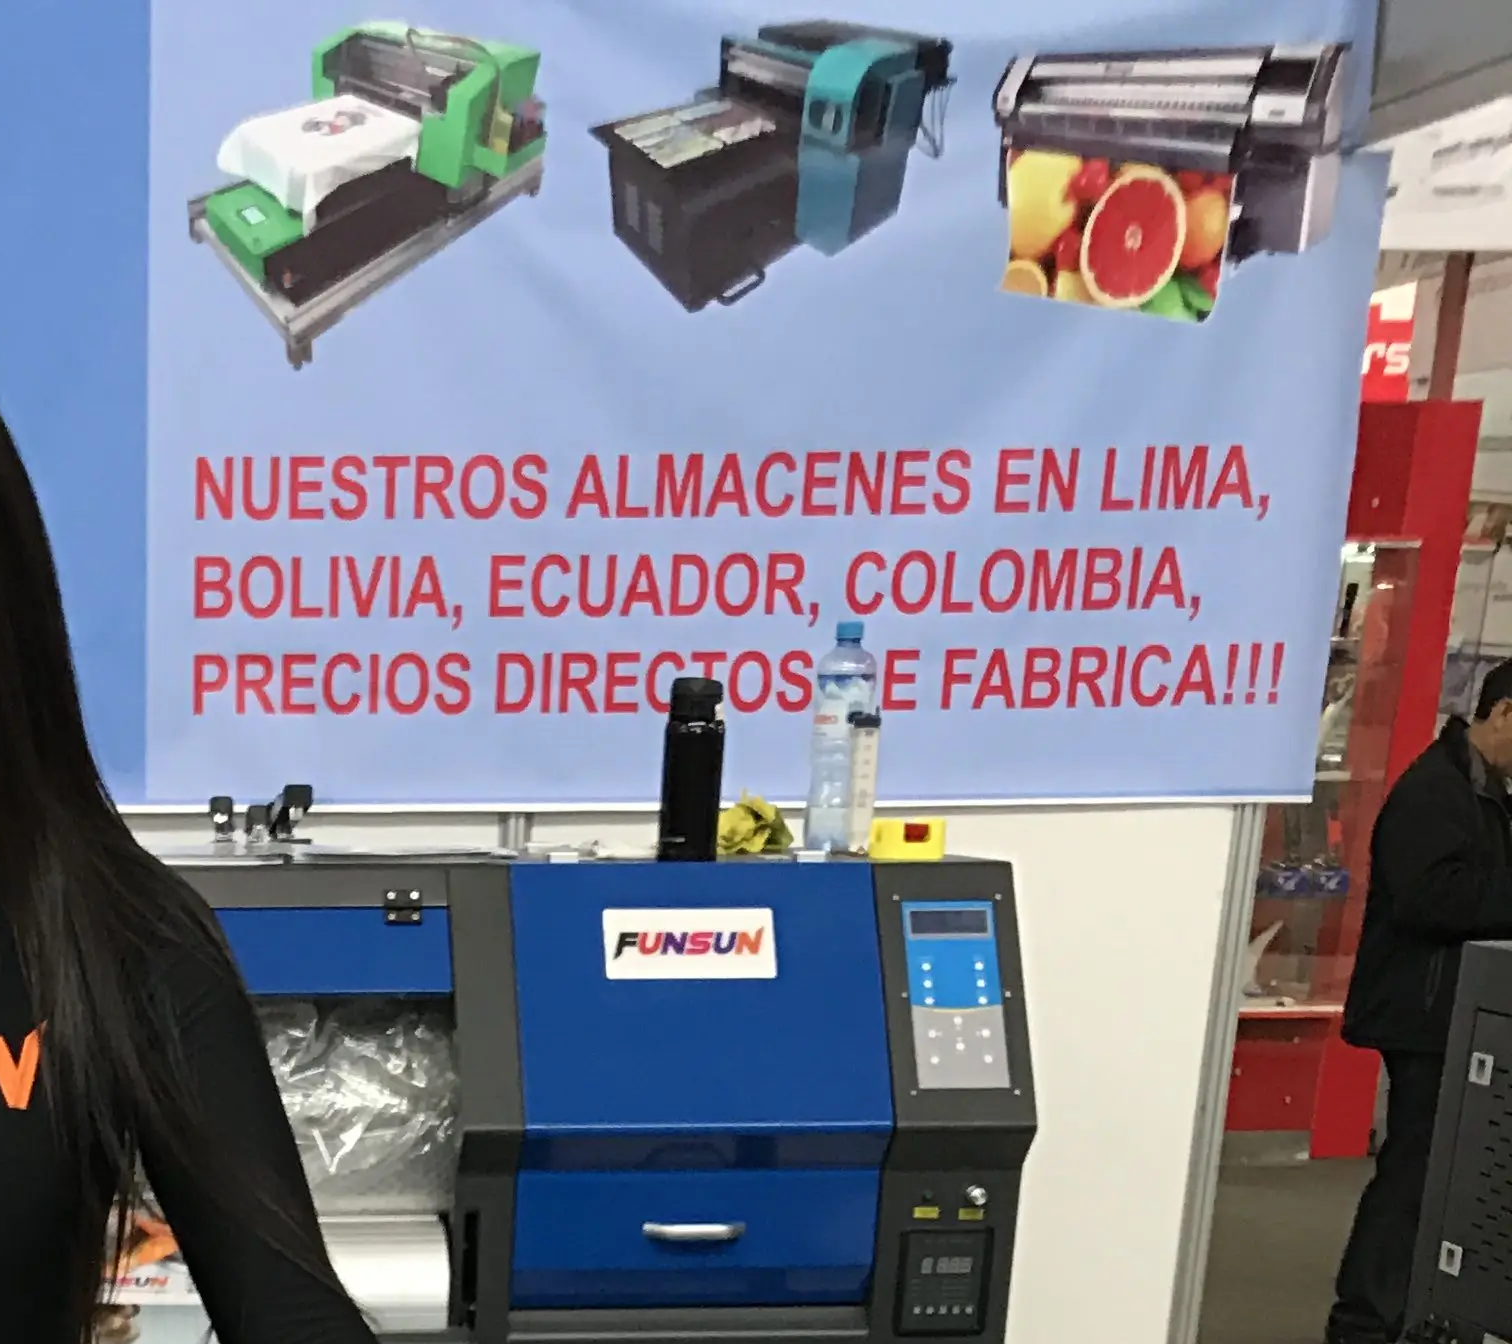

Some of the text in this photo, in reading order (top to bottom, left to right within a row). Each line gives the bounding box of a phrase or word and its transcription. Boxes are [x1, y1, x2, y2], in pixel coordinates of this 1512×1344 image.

[194, 445, 1271, 521] NUESTROS ALMACENES EN LIMA,
[193, 546, 1202, 631] BOLIVIA, ECUADOR, COLOMBIA,
[193, 652, 472, 717] PRECIOS
[495, 650, 815, 716] DIRECTOS
[939, 642, 1286, 710] FABRICA!!!
[612, 926, 765, 960] FUNSUN
